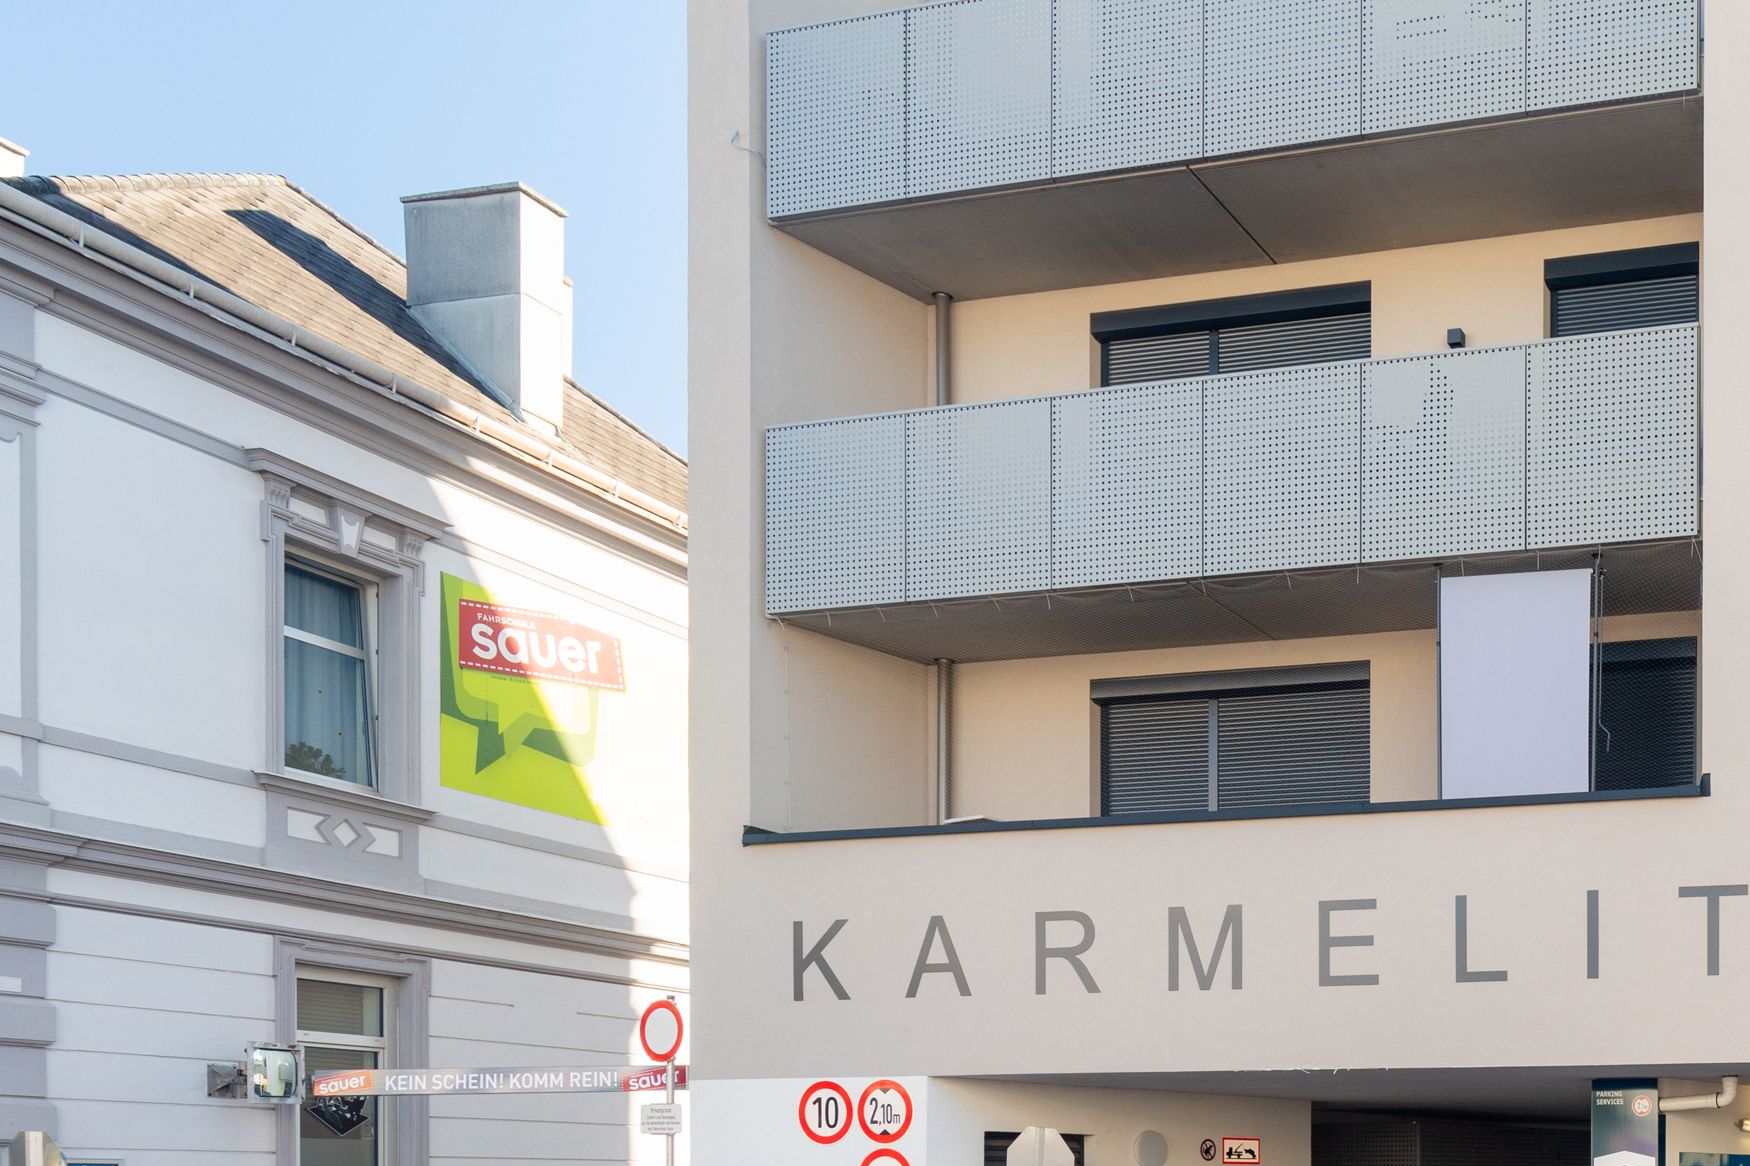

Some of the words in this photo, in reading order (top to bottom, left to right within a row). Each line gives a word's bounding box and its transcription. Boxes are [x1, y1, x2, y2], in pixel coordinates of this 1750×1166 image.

[477, 613, 536, 630] FAHRSCHULE
[471, 623, 601, 675] sauer
[319, 1075, 366, 1094] sauer
[385, 1075, 426, 1091] KEIN
[432, 1073, 503, 1090] SCHEIN!
[510, 1072, 563, 1089] KOMM
[570, 1071, 618, 1087] REIN!
[1596, 1098, 1624, 1106] SERVICES
[812, 1096, 839, 1128] 10
